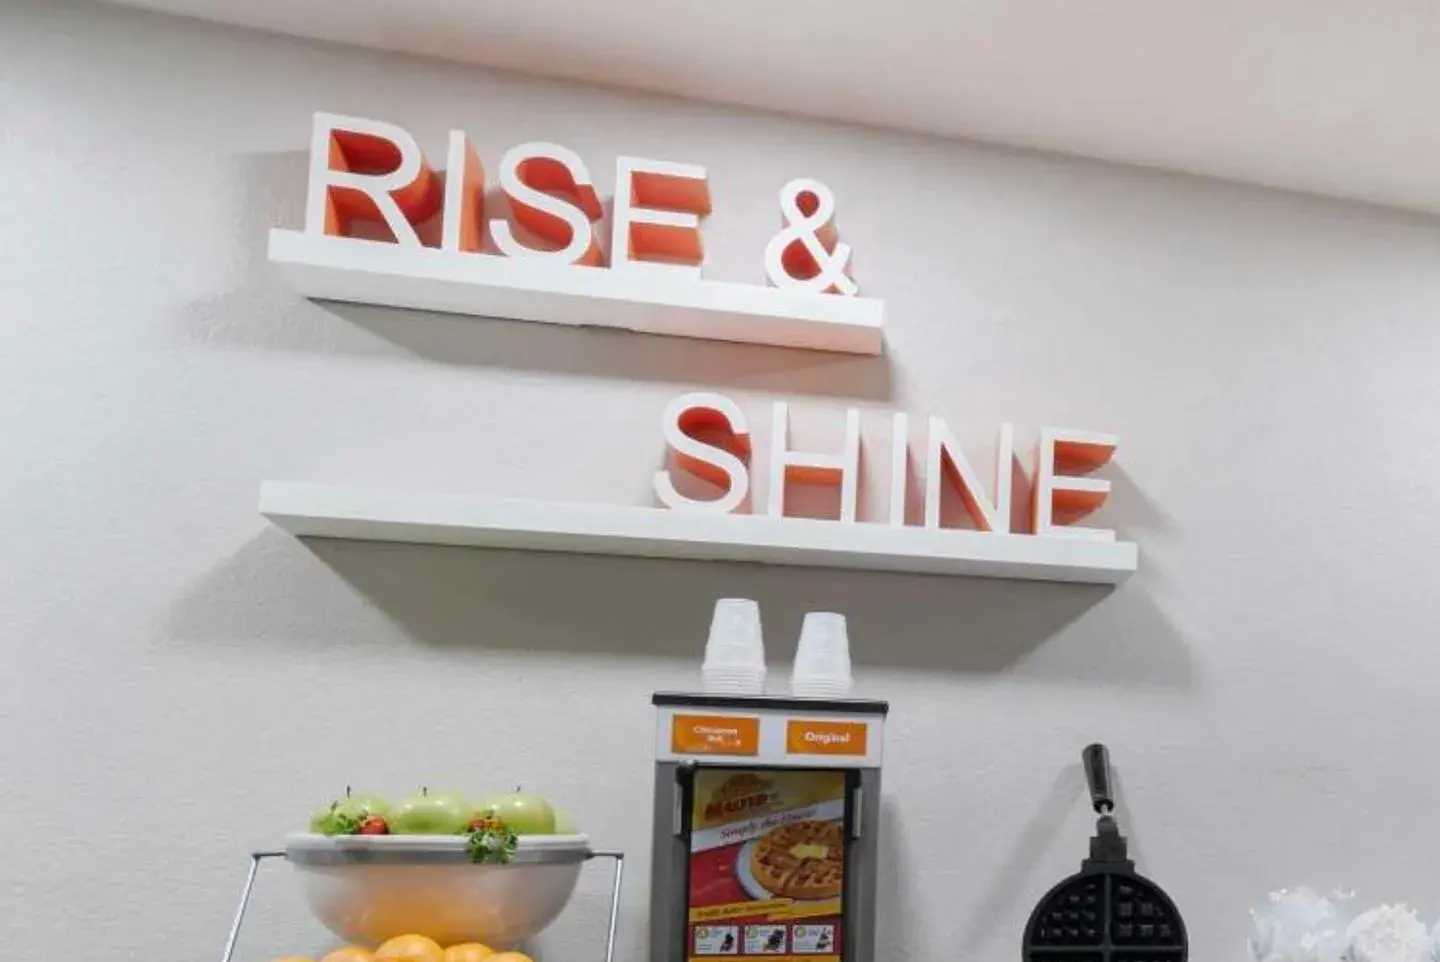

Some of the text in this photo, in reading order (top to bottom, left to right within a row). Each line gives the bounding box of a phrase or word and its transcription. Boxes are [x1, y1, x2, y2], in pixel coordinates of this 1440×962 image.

[305, 111, 858, 297] RISE &
[653, 392, 1118, 543] SHINE
[804, 731, 851, 746] Original
